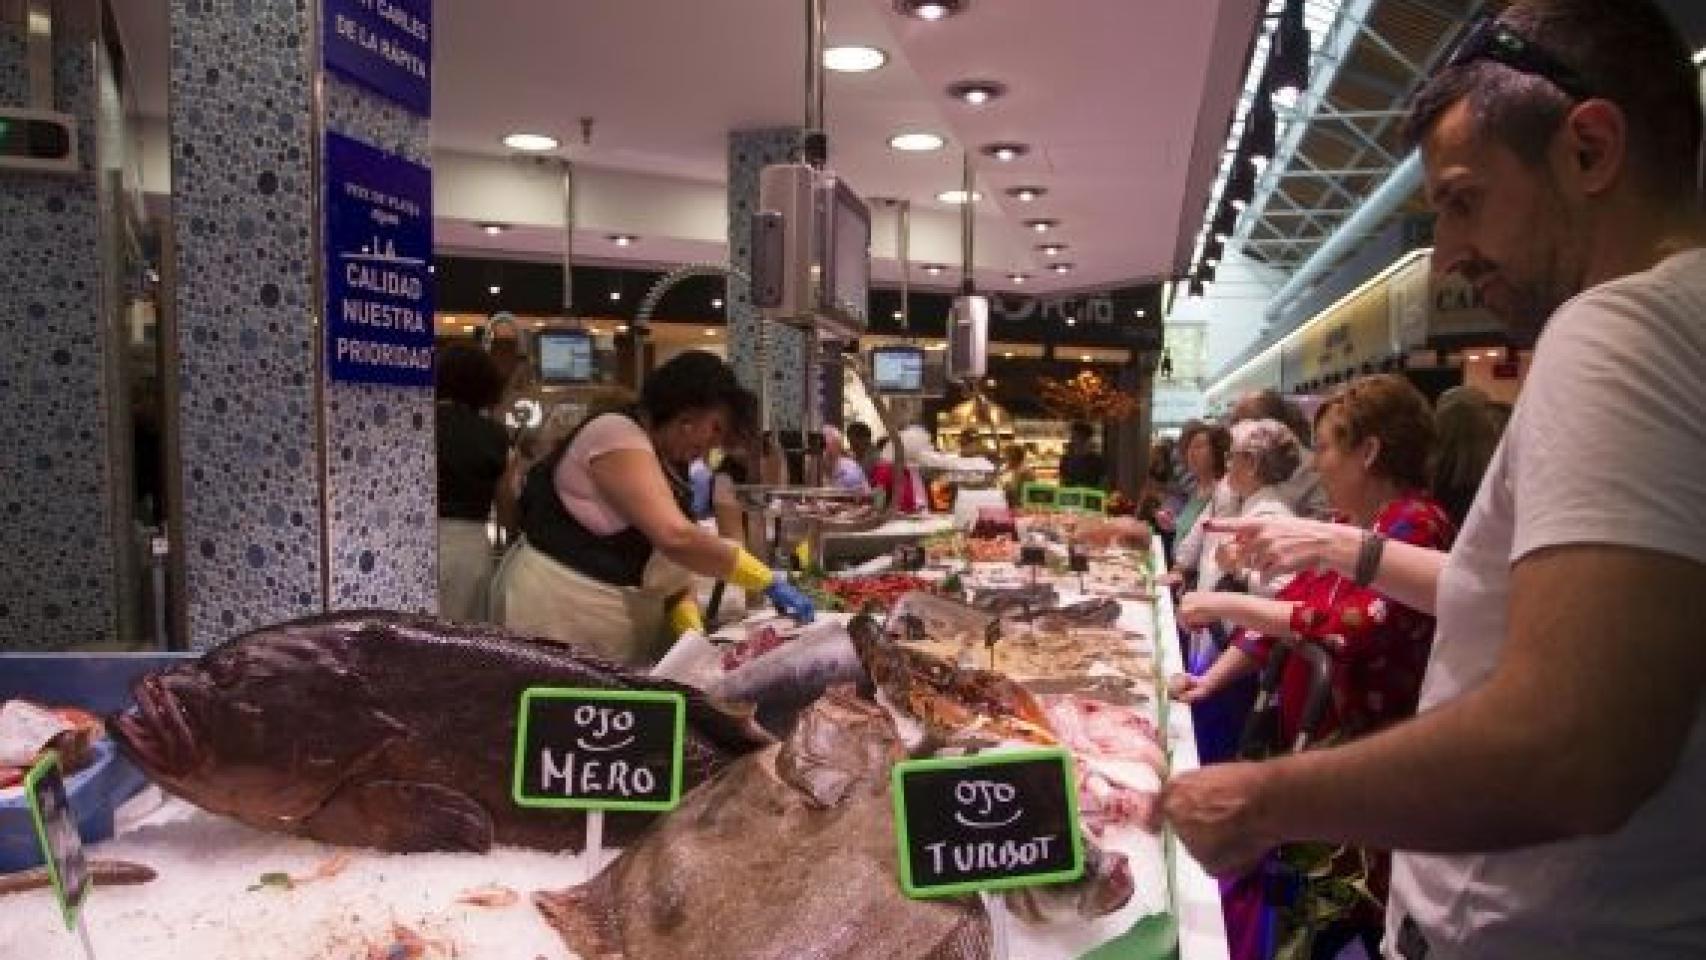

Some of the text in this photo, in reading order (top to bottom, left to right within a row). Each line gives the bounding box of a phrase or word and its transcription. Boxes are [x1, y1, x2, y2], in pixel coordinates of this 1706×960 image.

[335, 14, 356, 40] DE
[359, 26, 378, 50] LA
[373, 235, 396, 259] LA
[346, 262, 422, 299] CALIDAD
[343, 296, 425, 332] NUESTRA
[337, 337, 432, 369] PRIORIDAD
[574, 705, 635, 738] OJO
[540, 747, 656, 796] MERO
[924, 834, 1057, 875] TURBOT
